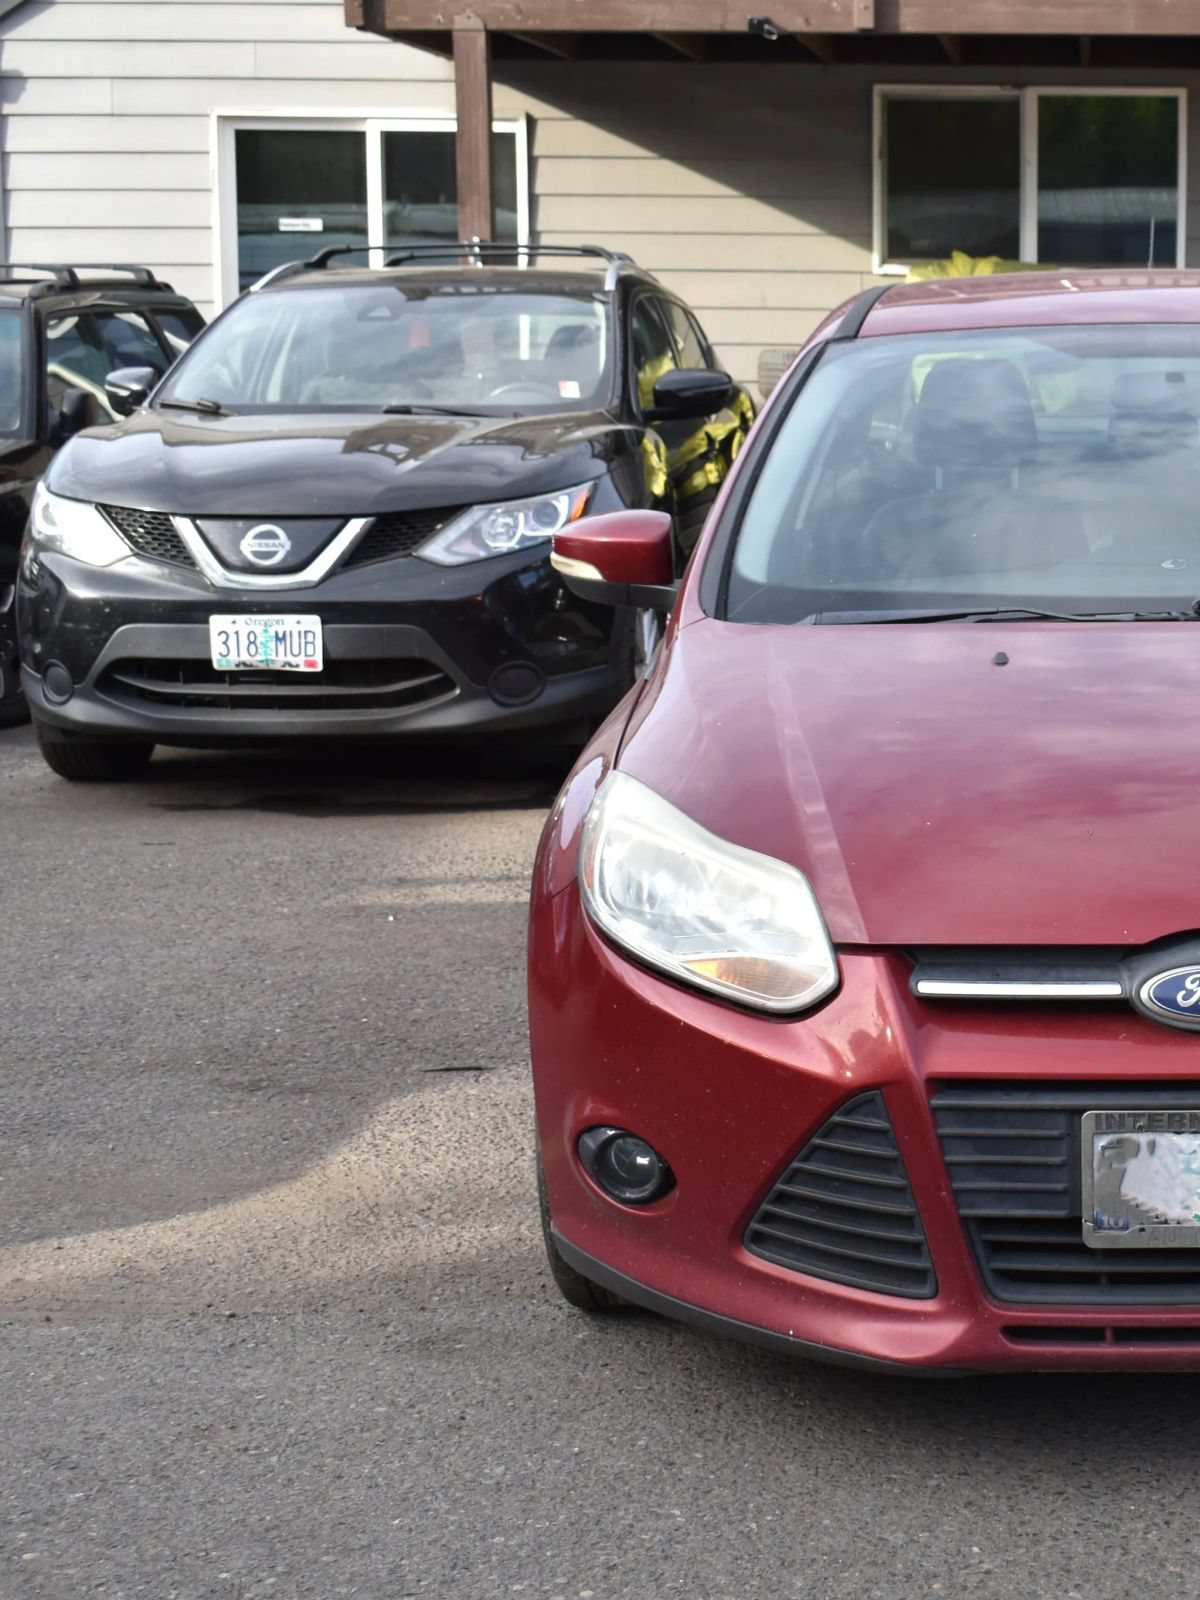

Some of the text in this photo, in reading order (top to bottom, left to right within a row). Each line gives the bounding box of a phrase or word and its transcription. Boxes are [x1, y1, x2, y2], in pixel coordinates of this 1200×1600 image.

[247, 541, 286, 549] NISSAN
[245, 617, 285, 628] Oregon
[217, 630, 316, 658] 318 MUB
